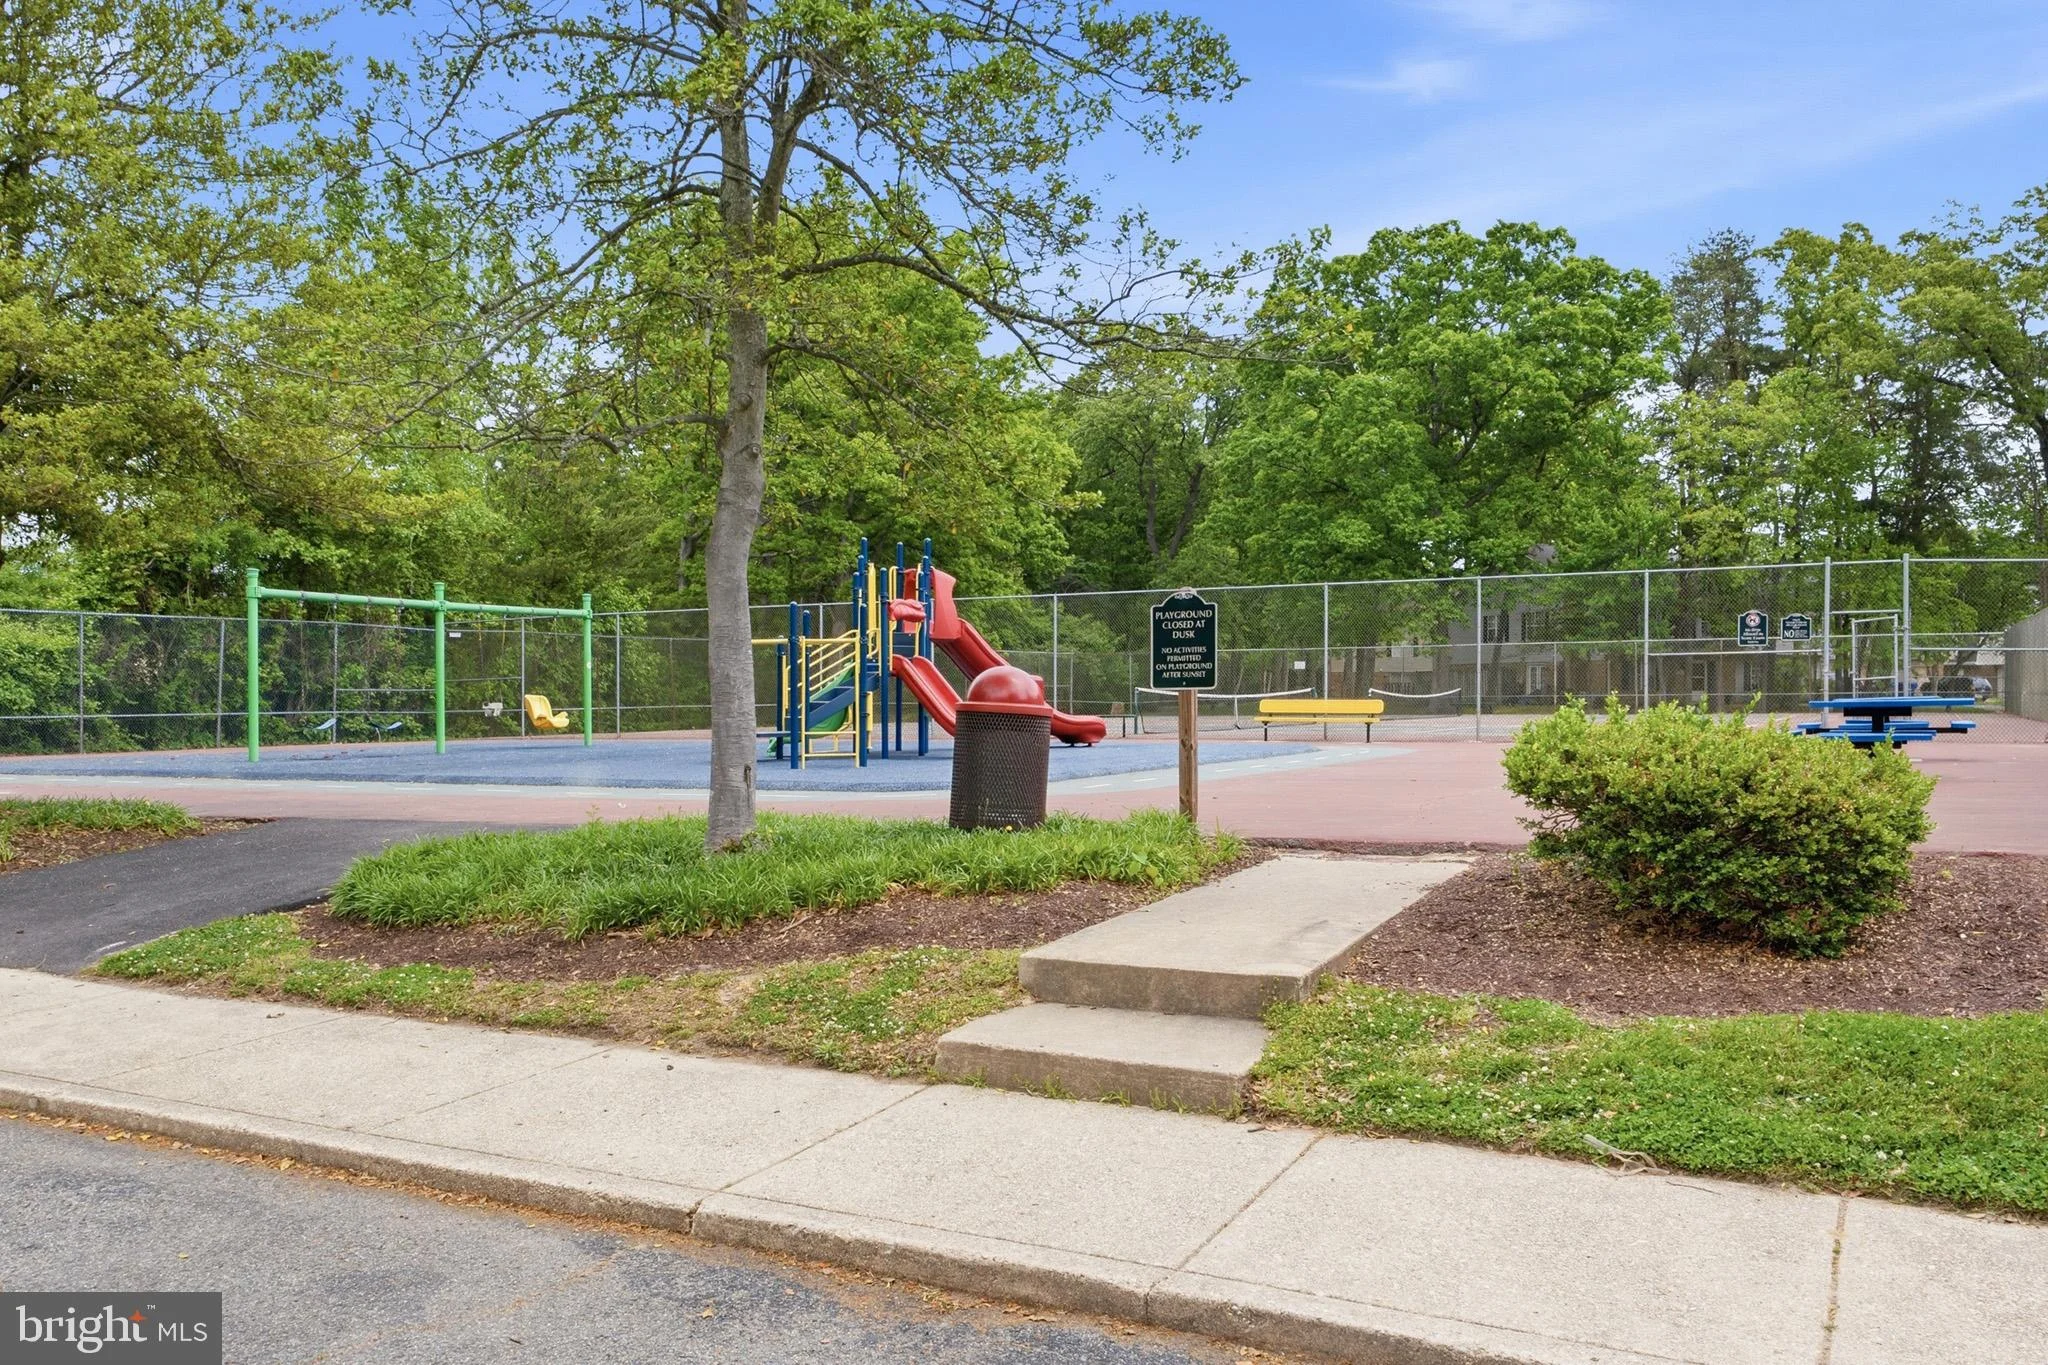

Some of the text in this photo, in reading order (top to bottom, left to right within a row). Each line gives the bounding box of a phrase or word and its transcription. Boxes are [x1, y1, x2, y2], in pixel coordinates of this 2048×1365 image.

[1155, 609, 1213, 620] PLAYGROUND
[1162, 620, 1206, 630] CLOSED AT
[1172, 630, 1195, 639] DUSK
[1784, 629, 1795, 638] NO
[1173, 646, 1207, 654] ACTIVITIES
[1166, 654, 1201, 662] PERMITTED
[1155, 662, 1213, 671] ON PLAYGROUND
[1182, 670, 1206, 678] SUNSET
